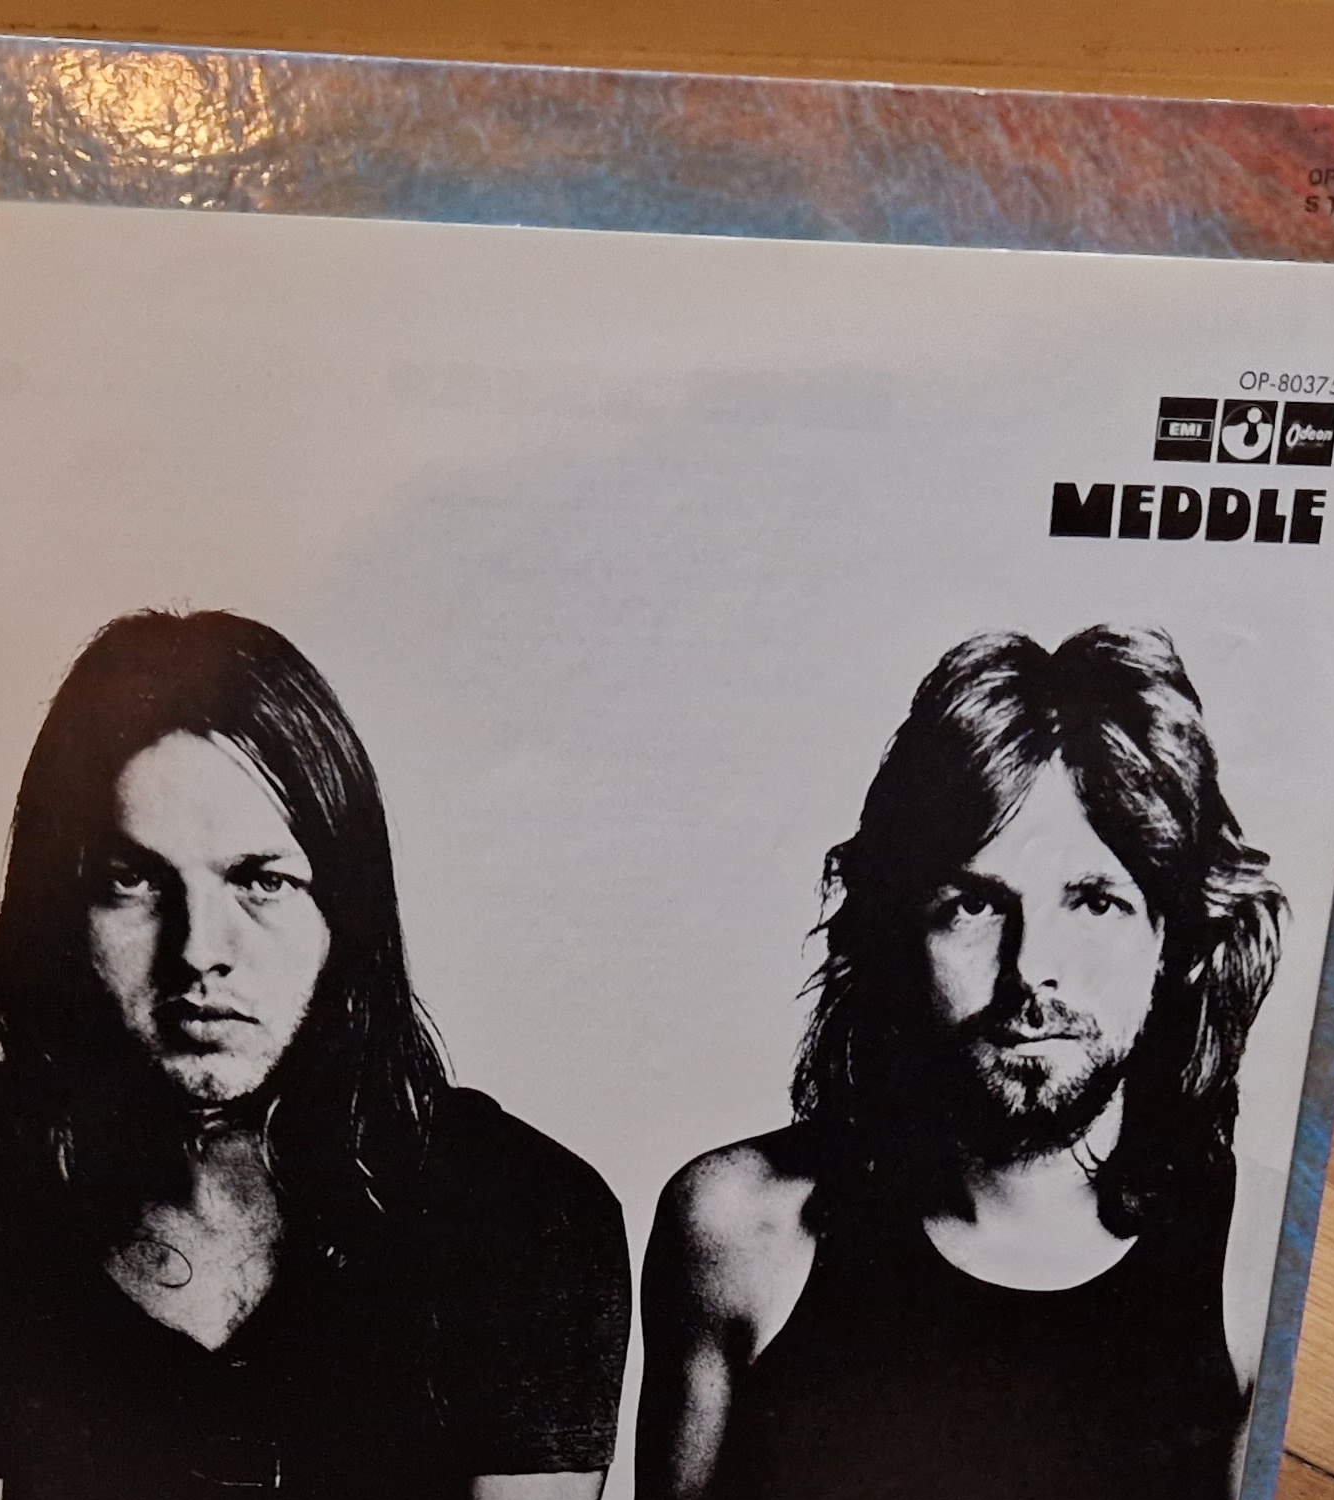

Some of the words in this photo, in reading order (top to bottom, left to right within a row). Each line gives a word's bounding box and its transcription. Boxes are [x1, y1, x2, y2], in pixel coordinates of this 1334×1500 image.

[1167, 421, 1204, 438] EMI
[1284, 422, 1334, 448] Odeon
[1048, 481, 1328, 545] MEDDLE
